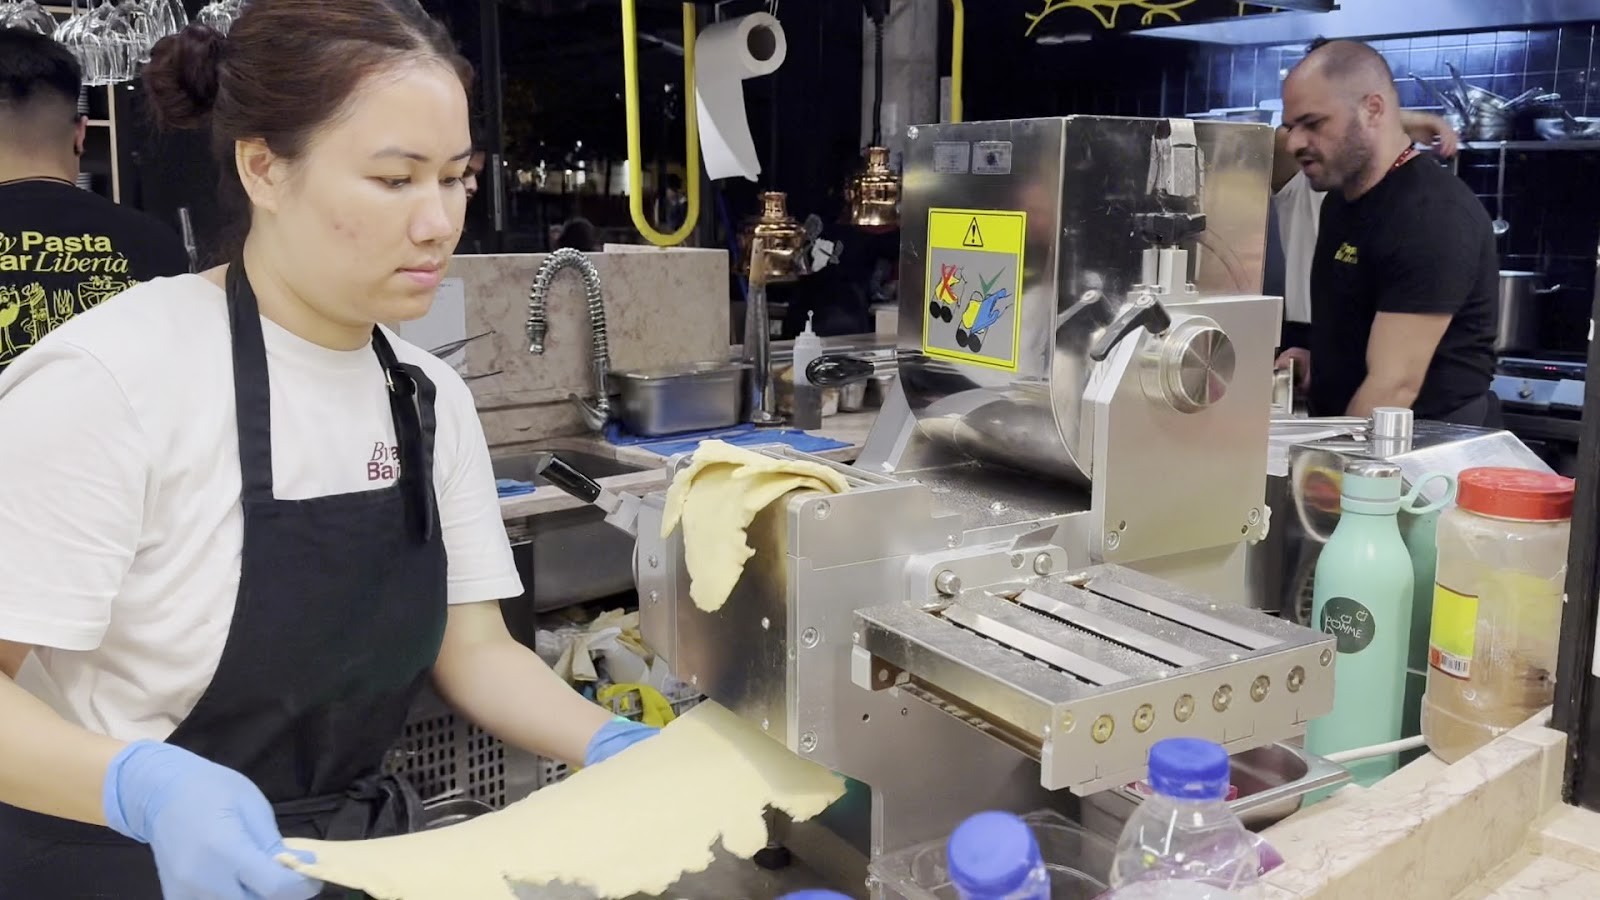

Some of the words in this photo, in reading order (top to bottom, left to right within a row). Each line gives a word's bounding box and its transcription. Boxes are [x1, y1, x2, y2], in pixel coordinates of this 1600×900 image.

[0, 231, 17, 254] y
[21, 231, 112, 252] Pasta
[0, 254, 33, 271] ar
[33, 251, 129, 273] Libertà
